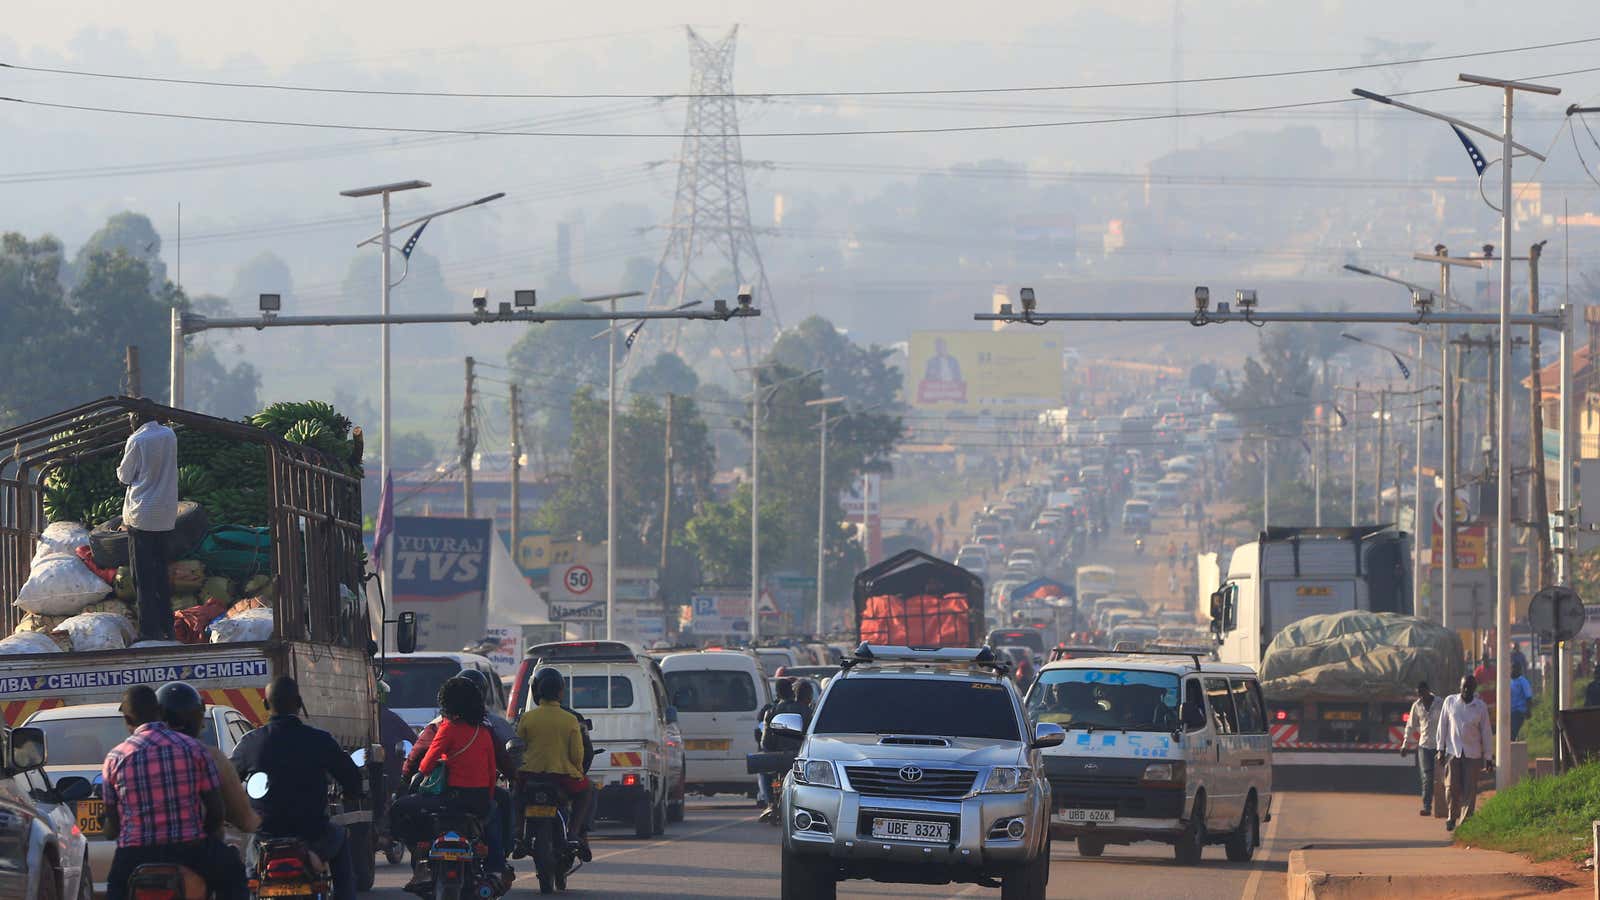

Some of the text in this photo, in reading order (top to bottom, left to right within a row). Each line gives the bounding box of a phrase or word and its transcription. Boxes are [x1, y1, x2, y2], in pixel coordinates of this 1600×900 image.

[399, 536, 483, 552] YUVRAJ
[397, 552, 482, 581] TVS
[570, 572, 588, 587] 50
[48, 671, 121, 689] CEMENT
[122, 667, 178, 684] SIMBA
[194, 660, 266, 678] CEMENT
[89, 802, 105, 816] UB
[887, 822, 943, 837] UBE 832X
